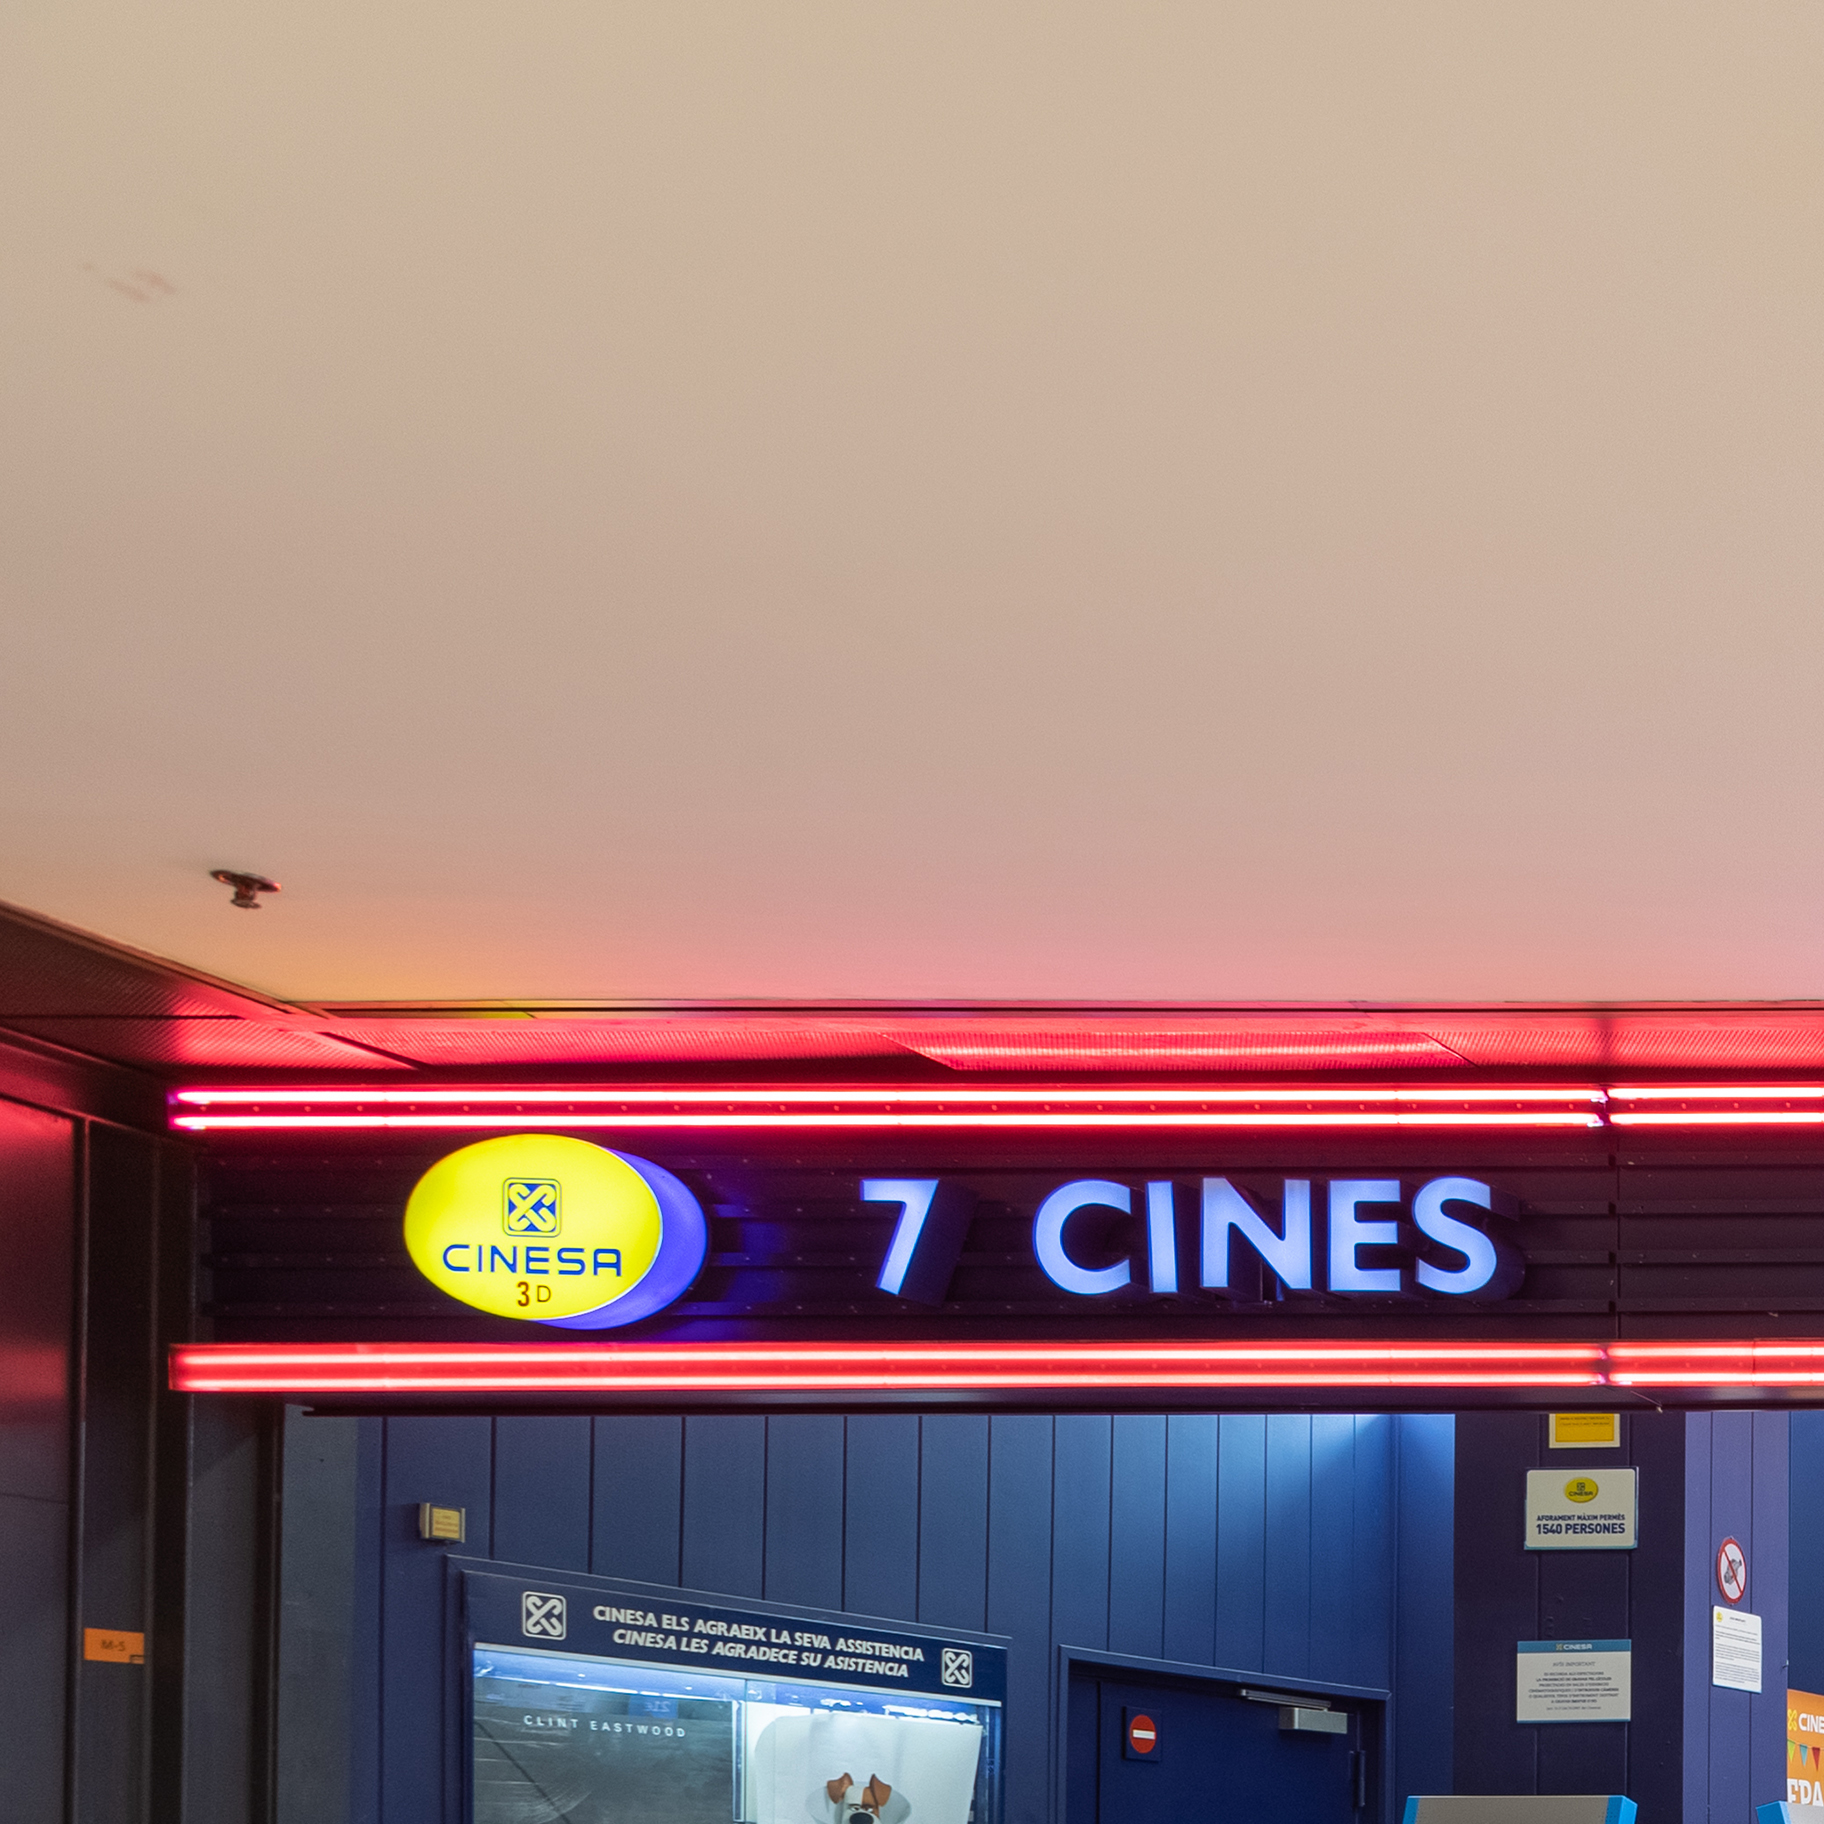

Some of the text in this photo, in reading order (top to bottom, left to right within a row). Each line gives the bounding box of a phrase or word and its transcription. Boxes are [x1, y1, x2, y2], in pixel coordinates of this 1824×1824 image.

[860, 1176, 1498, 1296] 7 CINES
[443, 1243, 622, 1278] CINESA
[1536, 1514, 1576, 1522] AFORAMENT
[1536, 1523, 1626, 1536] 1540 PERSONES
[593, 1605, 925, 1662] CINESA ELS AGRAEIX LA SEVA ASSISTENCIA
[613, 1628, 910, 1680] CINESA LES AGRADECE SU ASISTENCIA
[523, 1714, 688, 1740] CLINT EASTWOOD
